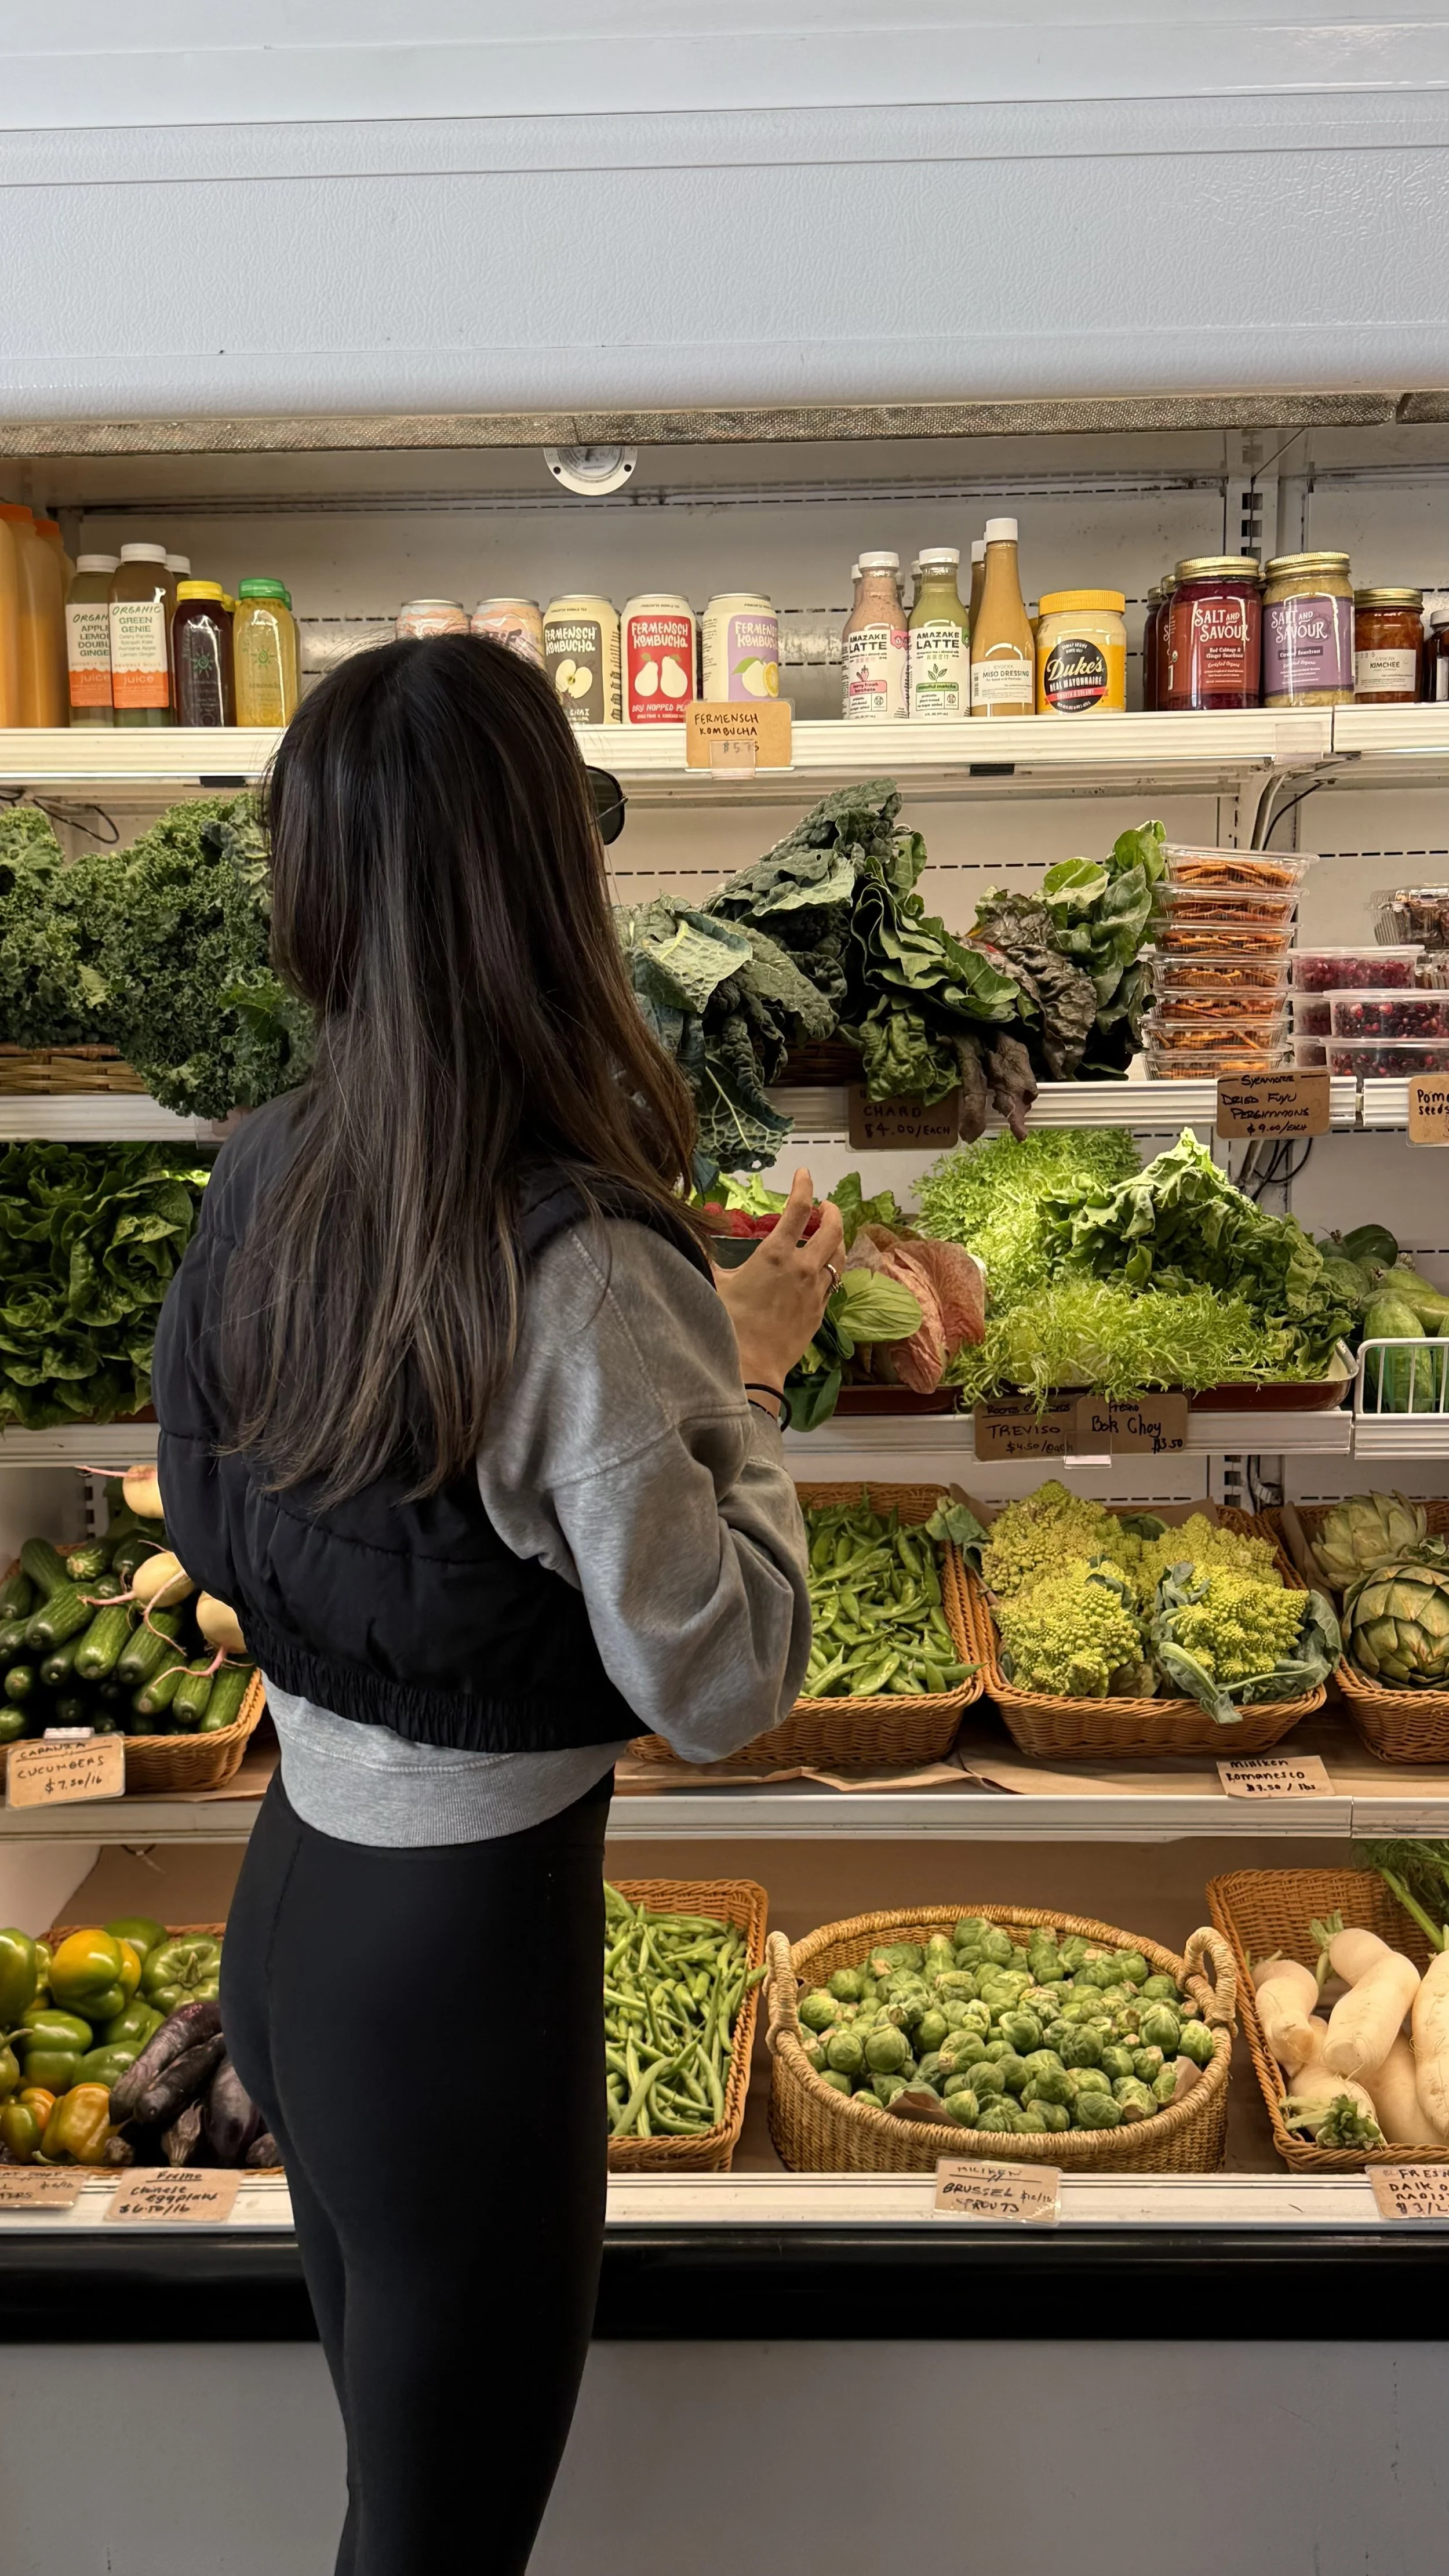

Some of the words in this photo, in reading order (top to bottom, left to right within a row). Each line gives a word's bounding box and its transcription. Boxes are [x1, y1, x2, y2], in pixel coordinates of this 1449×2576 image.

[112, 606, 162, 616] ORGANIC
[1194, 609, 1226, 627] SALT
[1226, 612, 1240, 625] AND
[73, 614, 108, 623] ORGAN
[1271, 610, 1298, 628] SALT
[1298, 611, 1313, 625] AND
[545, 626, 595, 643] FERMENSCH
[631, 621, 688, 635] FERMENSCH
[735, 621, 778, 637] FERMENS
[1200, 624, 1250, 642] SAVOUR
[1276, 621, 1327, 643] SAVOUR
[737, 634, 778, 650] KOMBUC
[850, 634, 887, 642] AMAZAKE
[917, 639, 959, 649] LATTE
[850, 642, 887, 653] LATTE
[1047, 657, 1103, 681] Duke's
[123, 675, 154, 685] juice
[1050, 681, 1062, 692] REAL
[1064, 676, 1102, 688] MAYONNAISE
[694, 713, 759, 725] FERMENSCH
[700, 727, 758, 736] KOMBUCHA
[1220, 1093, 1259, 1106] DRIED
[863, 1106, 922, 1118] CHARD
[986, 1424, 1061, 1439] TREVISO
[1091, 1414, 1119, 1433] Bok
[1127, 1414, 1162, 1438] Choy
[17, 1756, 105, 1779] CUCUMBERS
[1399, 2169, 1449, 2179] FRESN
[942, 2182, 1013, 2197] BRUSSEL
[1389, 2181, 1448, 2192] DAIKO
